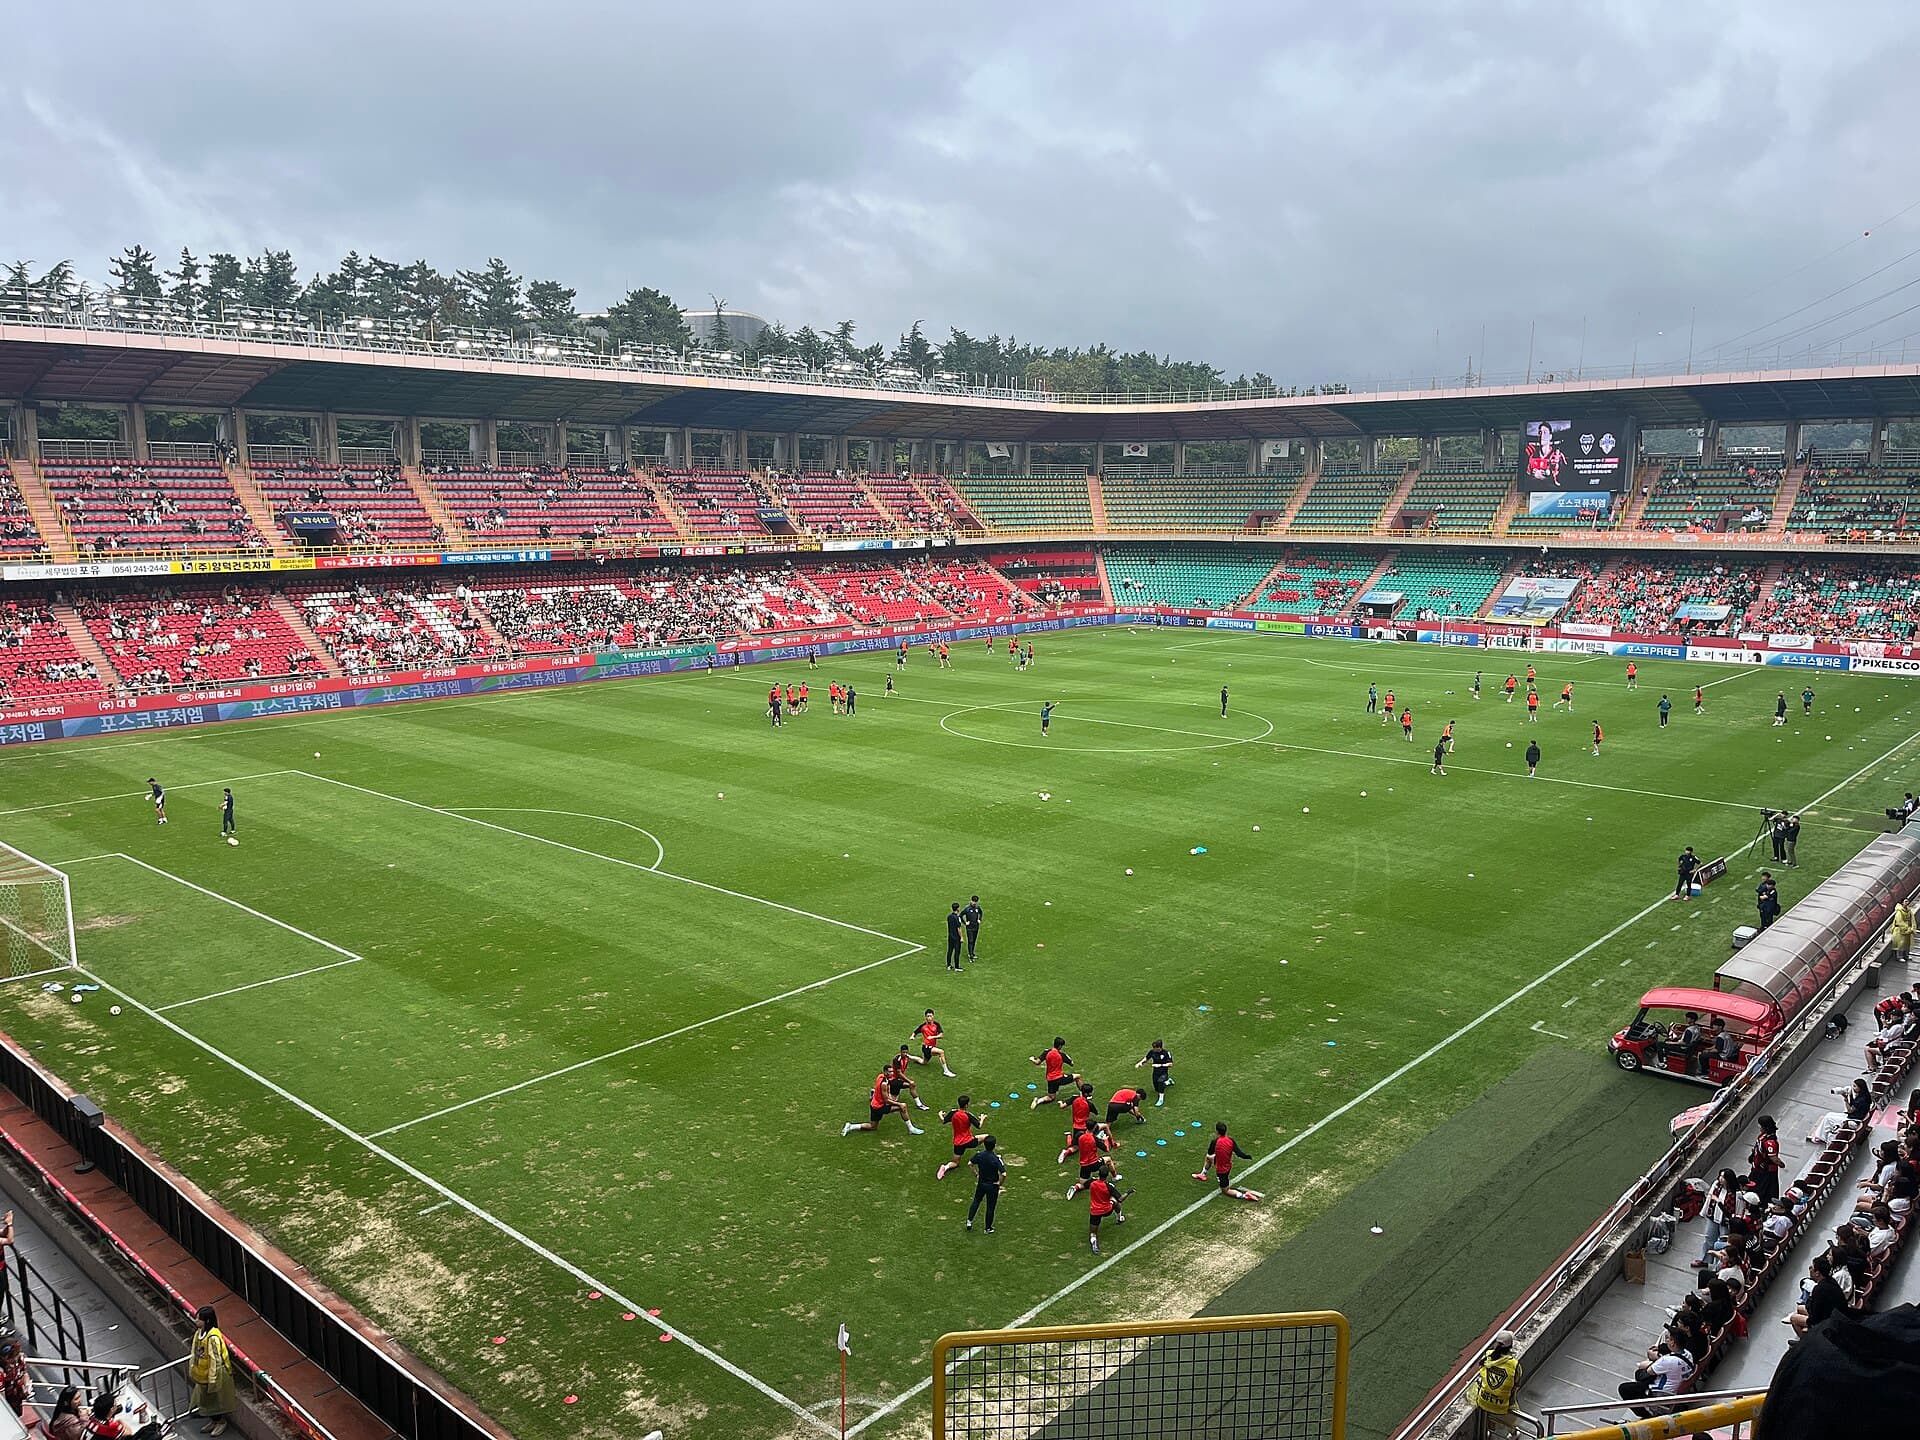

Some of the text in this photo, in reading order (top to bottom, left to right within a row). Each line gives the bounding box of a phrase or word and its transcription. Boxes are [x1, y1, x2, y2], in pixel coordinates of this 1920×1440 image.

[79, 565, 100, 576] 포유
[112, 564, 132, 574] (054)
[133, 564, 169, 573] 241-2442
[496, 669, 567, 690] 포스코퓨처엠
[599, 660, 661, 679] 포스코퓨처엠
[383, 679, 461, 702] 포스코퓨처엠
[252, 692, 342, 717] 포스코퓨처엠
[100, 706, 204, 733] 포스코퓨처엠
